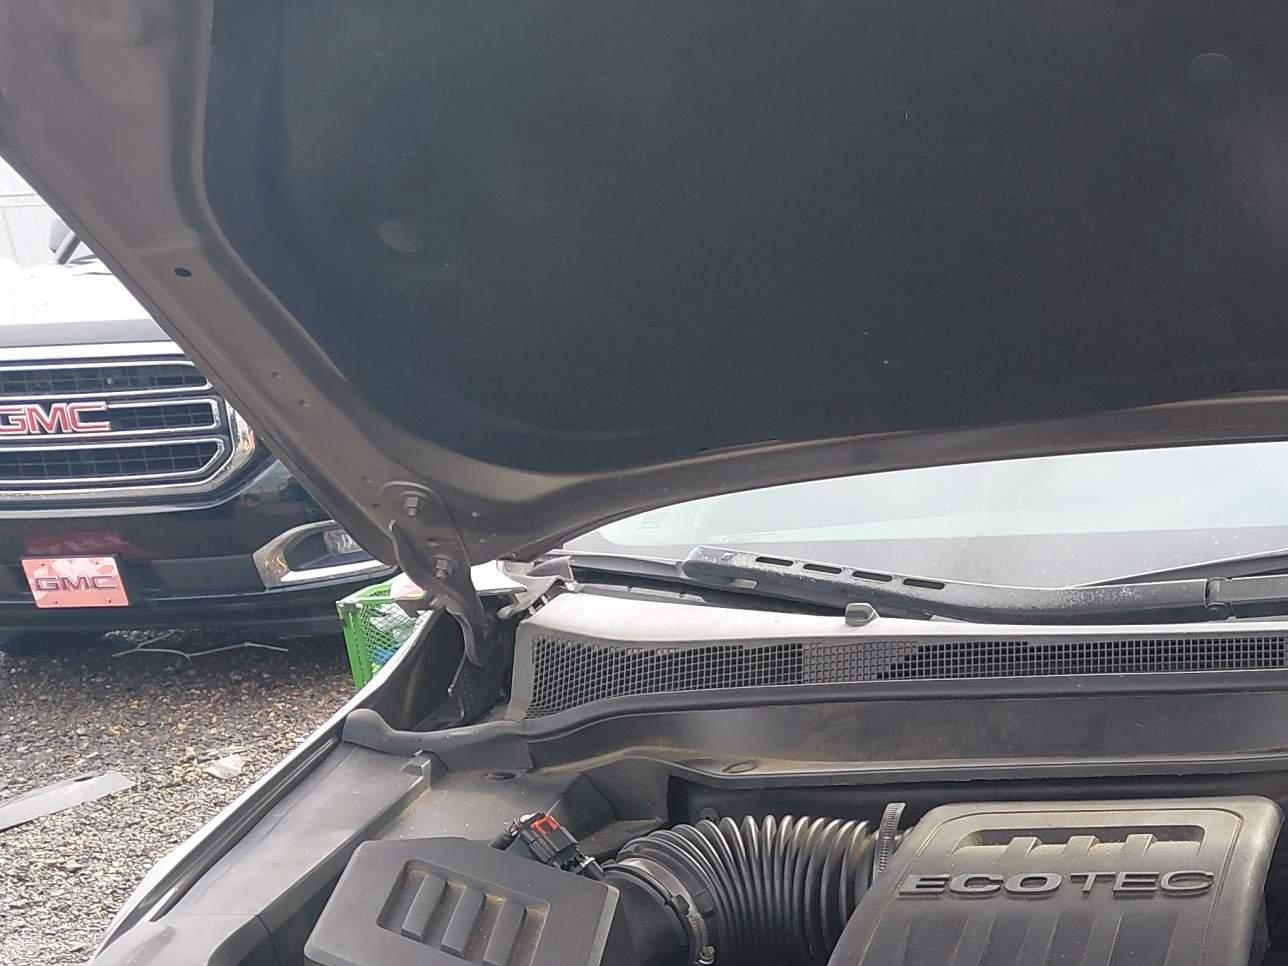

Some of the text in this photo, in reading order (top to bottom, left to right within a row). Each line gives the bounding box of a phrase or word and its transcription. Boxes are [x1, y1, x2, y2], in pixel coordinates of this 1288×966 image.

[0, 401, 112, 434] GMC
[35, 575, 117, 592] GMC
[897, 869, 1215, 899] ECOTEC
